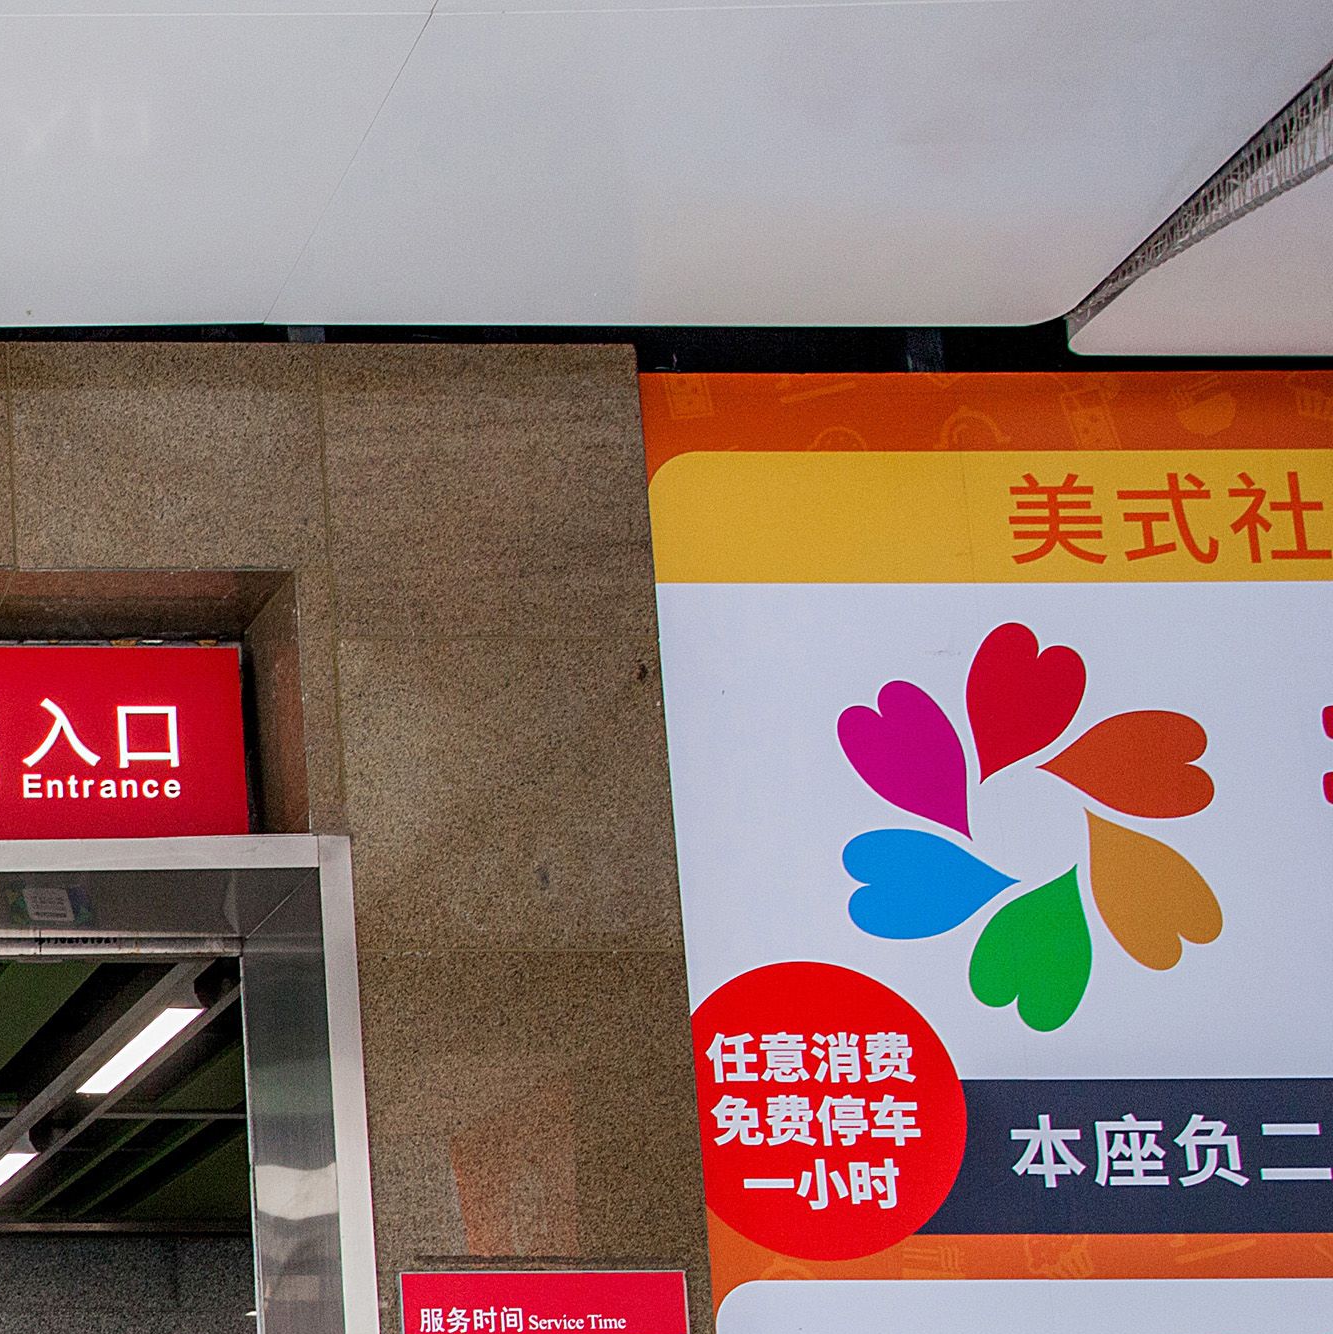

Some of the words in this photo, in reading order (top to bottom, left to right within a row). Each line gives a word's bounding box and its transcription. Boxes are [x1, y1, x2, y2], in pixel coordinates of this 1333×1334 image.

[1008, 472, 1333, 567] 美式社
[21, 697, 180, 770] 入口
[23, 773, 181, 800] Entrance
[705, 1031, 918, 1087] 任意消费
[710, 1094, 921, 1150] 免费停车
[1010, 1114, 1333, 1189] 本座负二
[743, 1157, 900, 1211] 一小时
[420, 1306, 523, 1333] 服务时间
[529, 1314, 584, 1330] Service
[587, 1314, 626, 1329] Time
